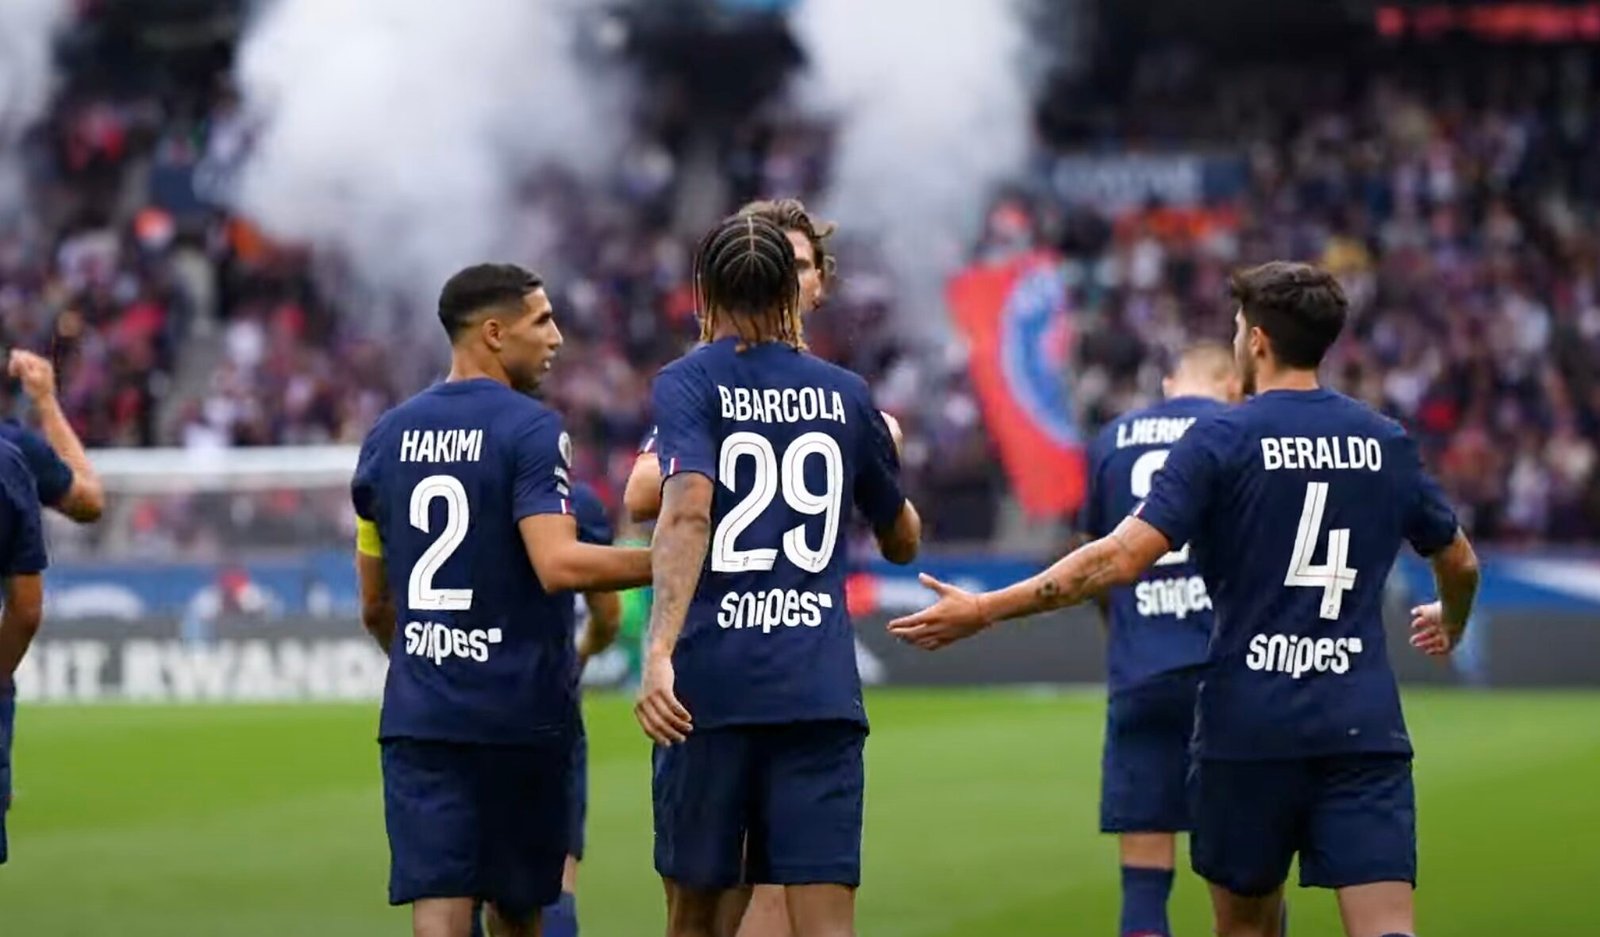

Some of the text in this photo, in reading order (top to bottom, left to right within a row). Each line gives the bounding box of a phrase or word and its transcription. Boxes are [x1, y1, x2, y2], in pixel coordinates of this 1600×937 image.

[400, 429, 483, 463] HAKIMI
[1260, 436, 1382, 472] BERALDO
[711, 431, 844, 573] 29
[408, 474, 474, 611] 2
[1283, 481, 1358, 620] 4
[717, 588, 822, 634] snipes
[1135, 576, 1213, 619] snipe
[1246, 633, 1351, 679] snipes
